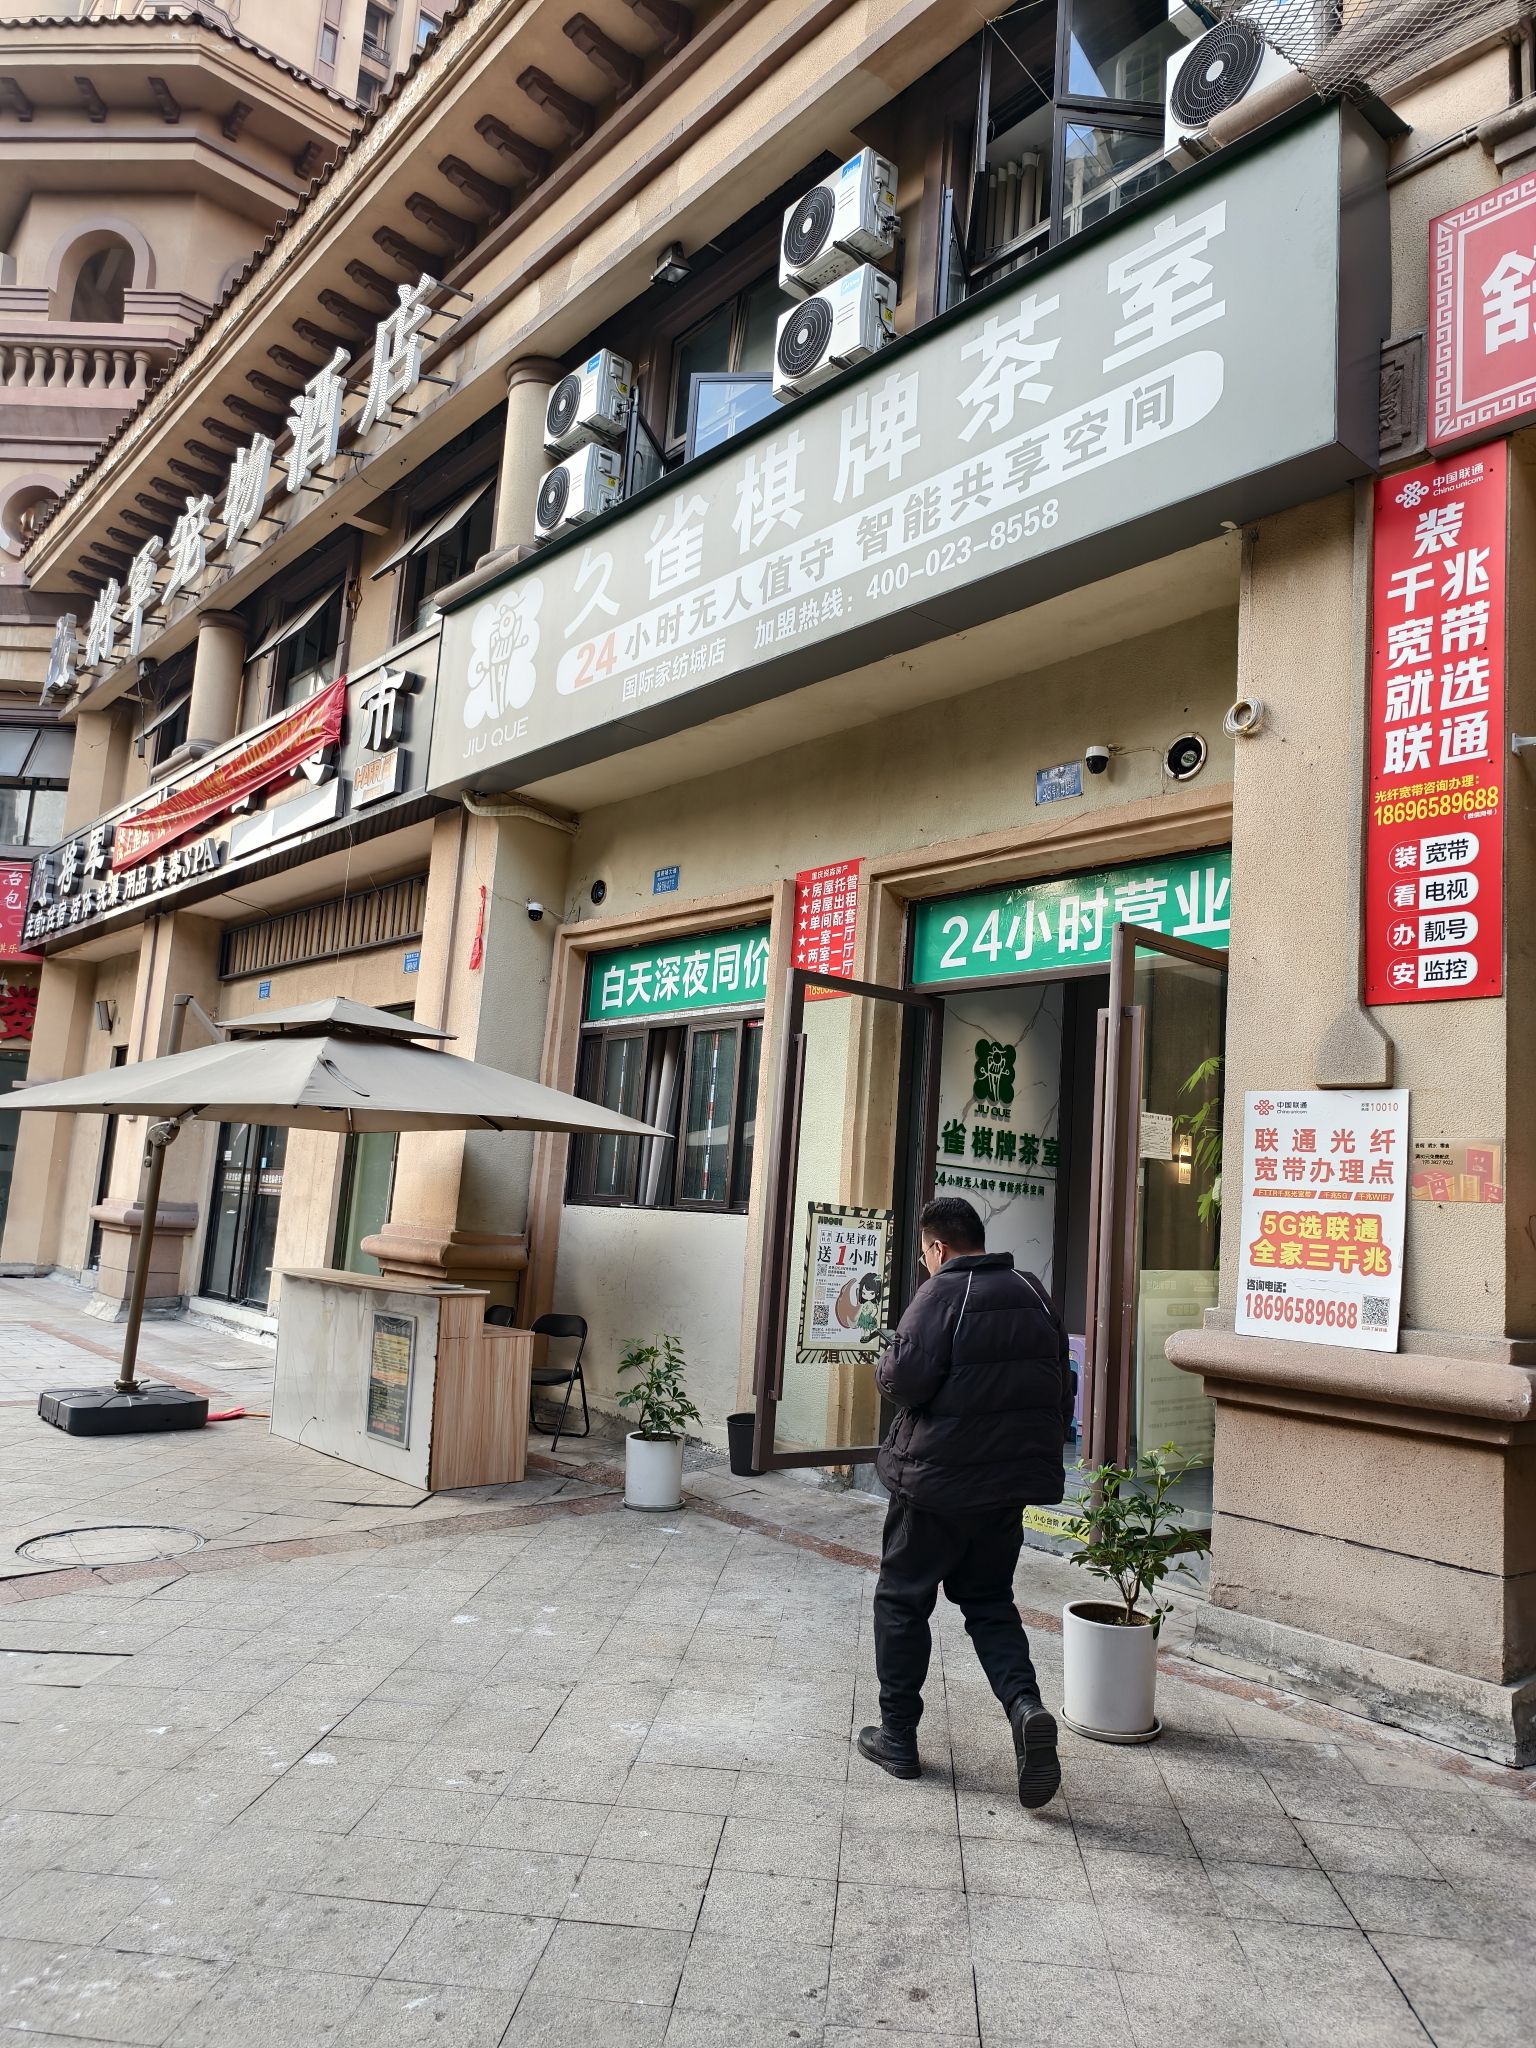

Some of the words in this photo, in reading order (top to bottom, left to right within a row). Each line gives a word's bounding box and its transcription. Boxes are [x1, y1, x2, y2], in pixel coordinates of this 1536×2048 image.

[564, 200, 1228, 639] 久雀棋牌茶室
[1433, 462, 1484, 488] 中国联通
[574, 537, 835, 689] 24小时无人值守
[855, 376, 1174, 562] 智能共享空间
[1413, 501, 1465, 559] 装
[866, 498, 1059, 600] 400-023-8558
[1386, 546, 1491, 614] 千兆
[1386, 600, 1491, 670] 宽带
[622, 638, 726, 702] 国际家纺城店
[1384, 656, 1490, 723] 就选
[360, 665, 406, 750] 市
[462, 733, 487, 759] JIU
[491, 717, 529, 748] QUE
[1383, 709, 1489, 775] 联通
[1373, 785, 1499, 827] 18696589688
[1374, 775, 1480, 803] 光纤宽带咨询办理：
[1394, 845, 1418, 869] 装
[1425, 838, 1470, 865] 宽带
[810, 891, 857, 915] 房屋出租
[811, 873, 859, 899] 房屋托管
[1393, 883, 1416, 907] 看
[1425, 878, 1468, 902] 电视
[808, 925, 856, 946] 一室一厅
[809, 908, 856, 931] 单间配套
[939, 867, 1231, 969] 24小时营业
[1392, 924, 1416, 947] 办
[1424, 918, 1468, 943] 靓号
[807, 942, 854, 964] 两室一厅
[601, 938, 770, 1012] 白天深夜同价
[1392, 962, 1416, 986] 安
[1423, 958, 1468, 982] 监控
[974, 1104, 990, 1114] JIU
[990, 1106, 1012, 1118] QUE
[935, 1119, 1062, 1168] 雀棋牌茶室
[1255, 1128, 1396, 1154] 联通光纤
[1254, 1156, 1394, 1185] 宽带办理点
[834, 1232, 877, 1247] 五星评价
[1263, 1213, 1380, 1244] 5G选联通
[1253, 1239, 1389, 1274] 全家三千兆
[1245, 1293, 1358, 1330] 18696589688
